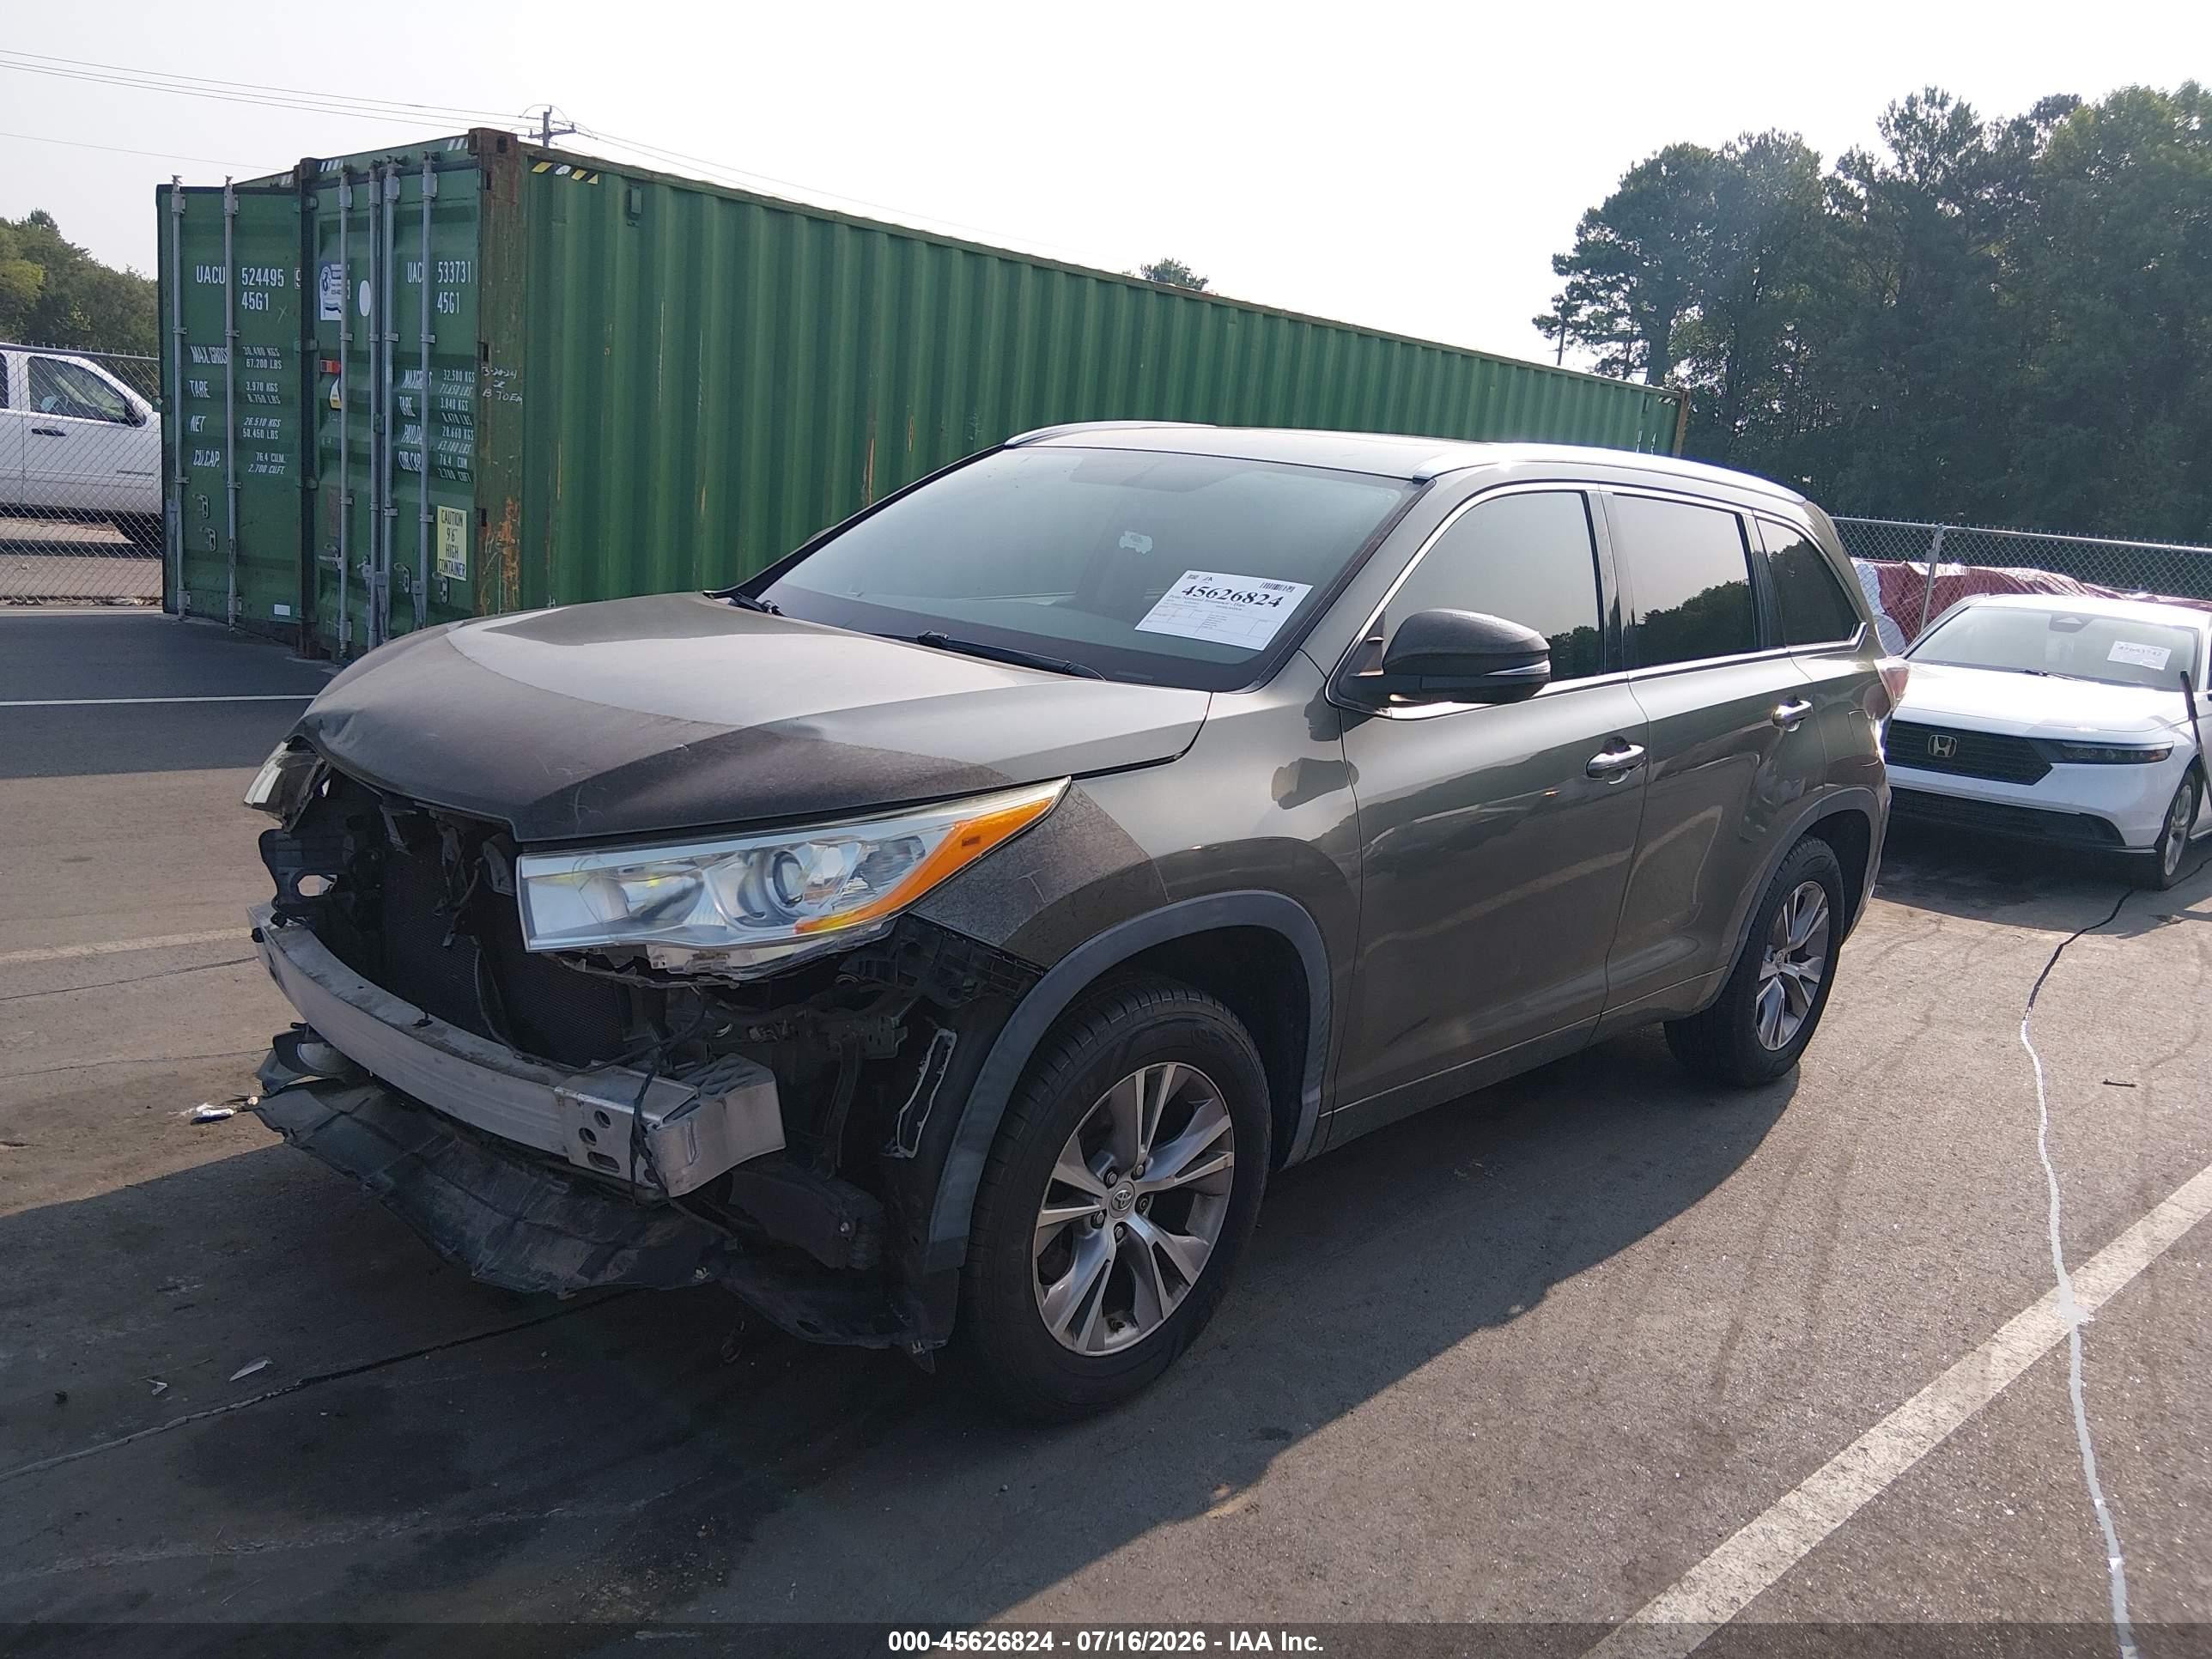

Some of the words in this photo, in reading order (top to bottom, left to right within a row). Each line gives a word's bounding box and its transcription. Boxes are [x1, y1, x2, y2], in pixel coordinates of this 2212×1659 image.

[196, 265, 226, 283] UACU
[241, 268, 284, 287] 524495
[408, 261, 424, 283] UAC
[438, 261, 471, 283] 533731
[241, 292, 269, 311] 45G1
[437, 292, 459, 314] 45G1
[270, 359, 282, 369] LBS
[465, 371, 475, 383] KGS
[189, 380, 210, 398] TARE
[246, 381, 264, 392] 3.970
[266, 383, 278, 392] KGS
[190, 415, 206, 433] NET
[268, 418, 282, 428] KGS
[441, 510, 463, 527] CAUTION
[446, 544, 459, 560] HIGH
[1182, 585, 1284, 608] 45626824
